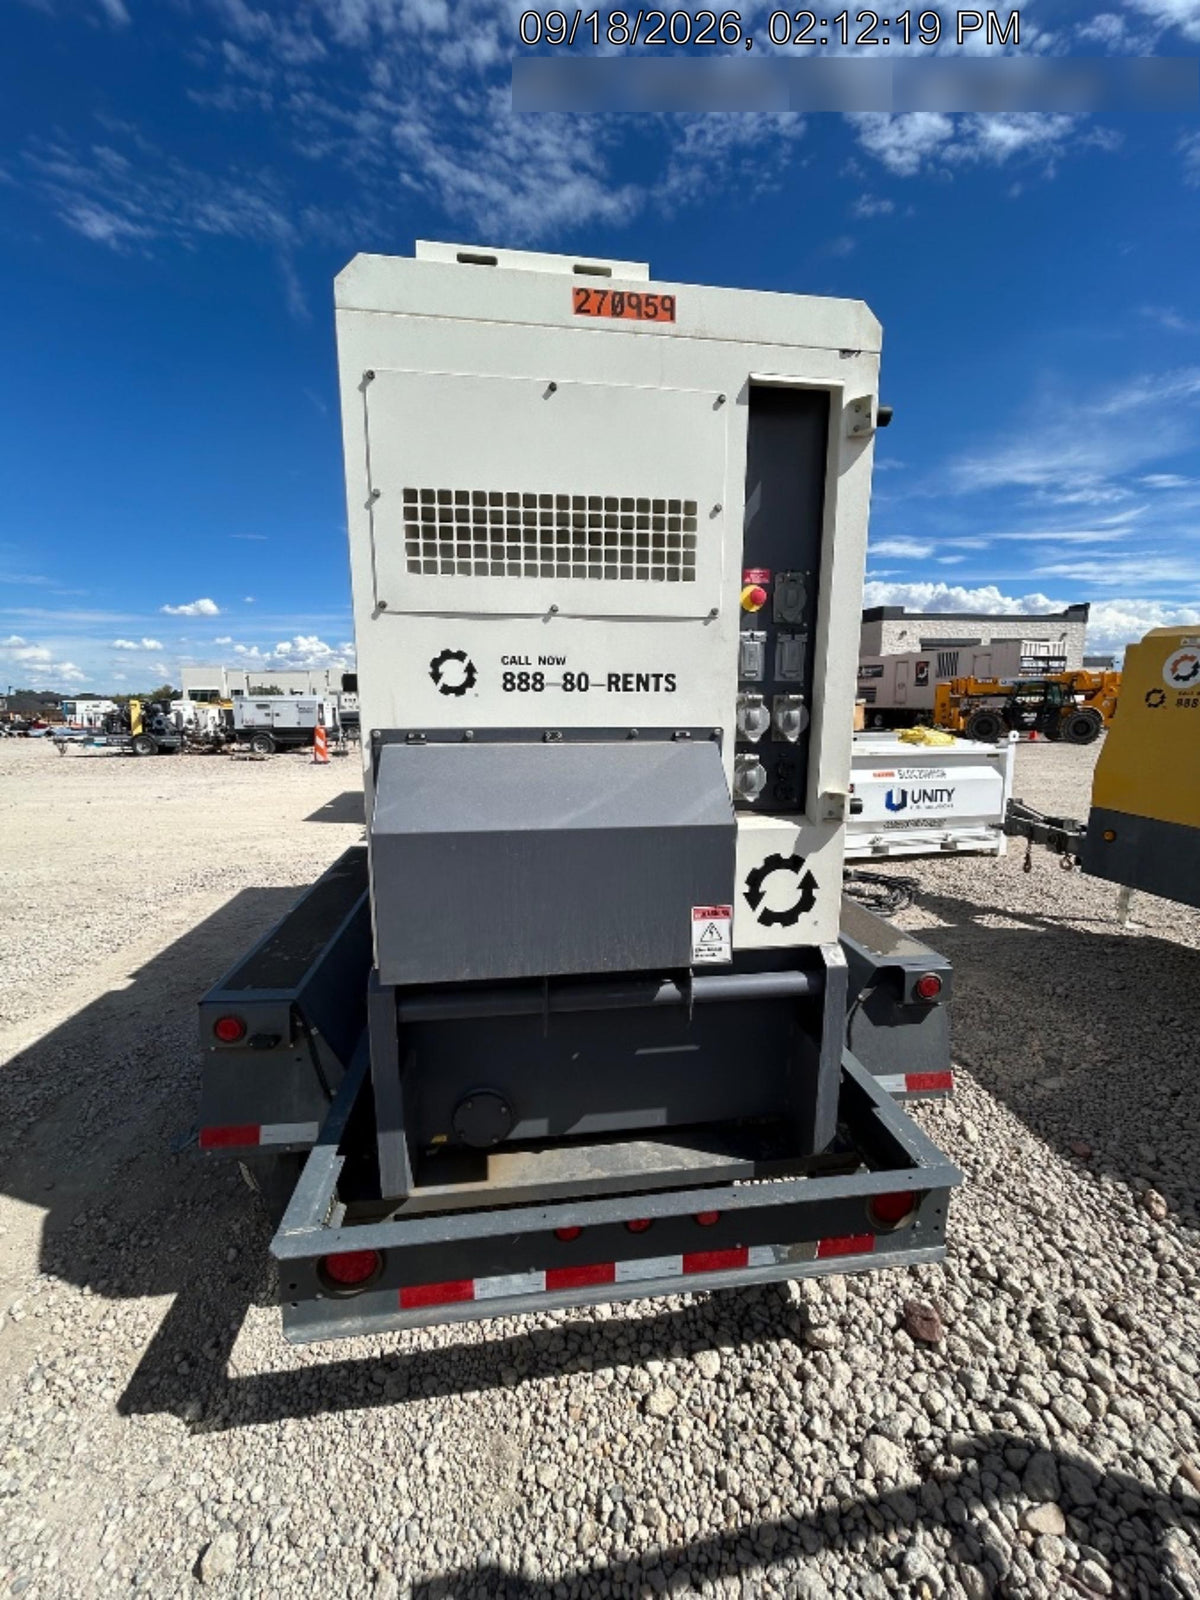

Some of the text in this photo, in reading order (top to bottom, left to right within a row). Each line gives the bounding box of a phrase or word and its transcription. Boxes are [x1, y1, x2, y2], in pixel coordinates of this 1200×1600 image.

[574, 287, 675, 322] 270959
[501, 655, 567, 666] CALL NOW
[911, 787, 955, 804] UNITY
